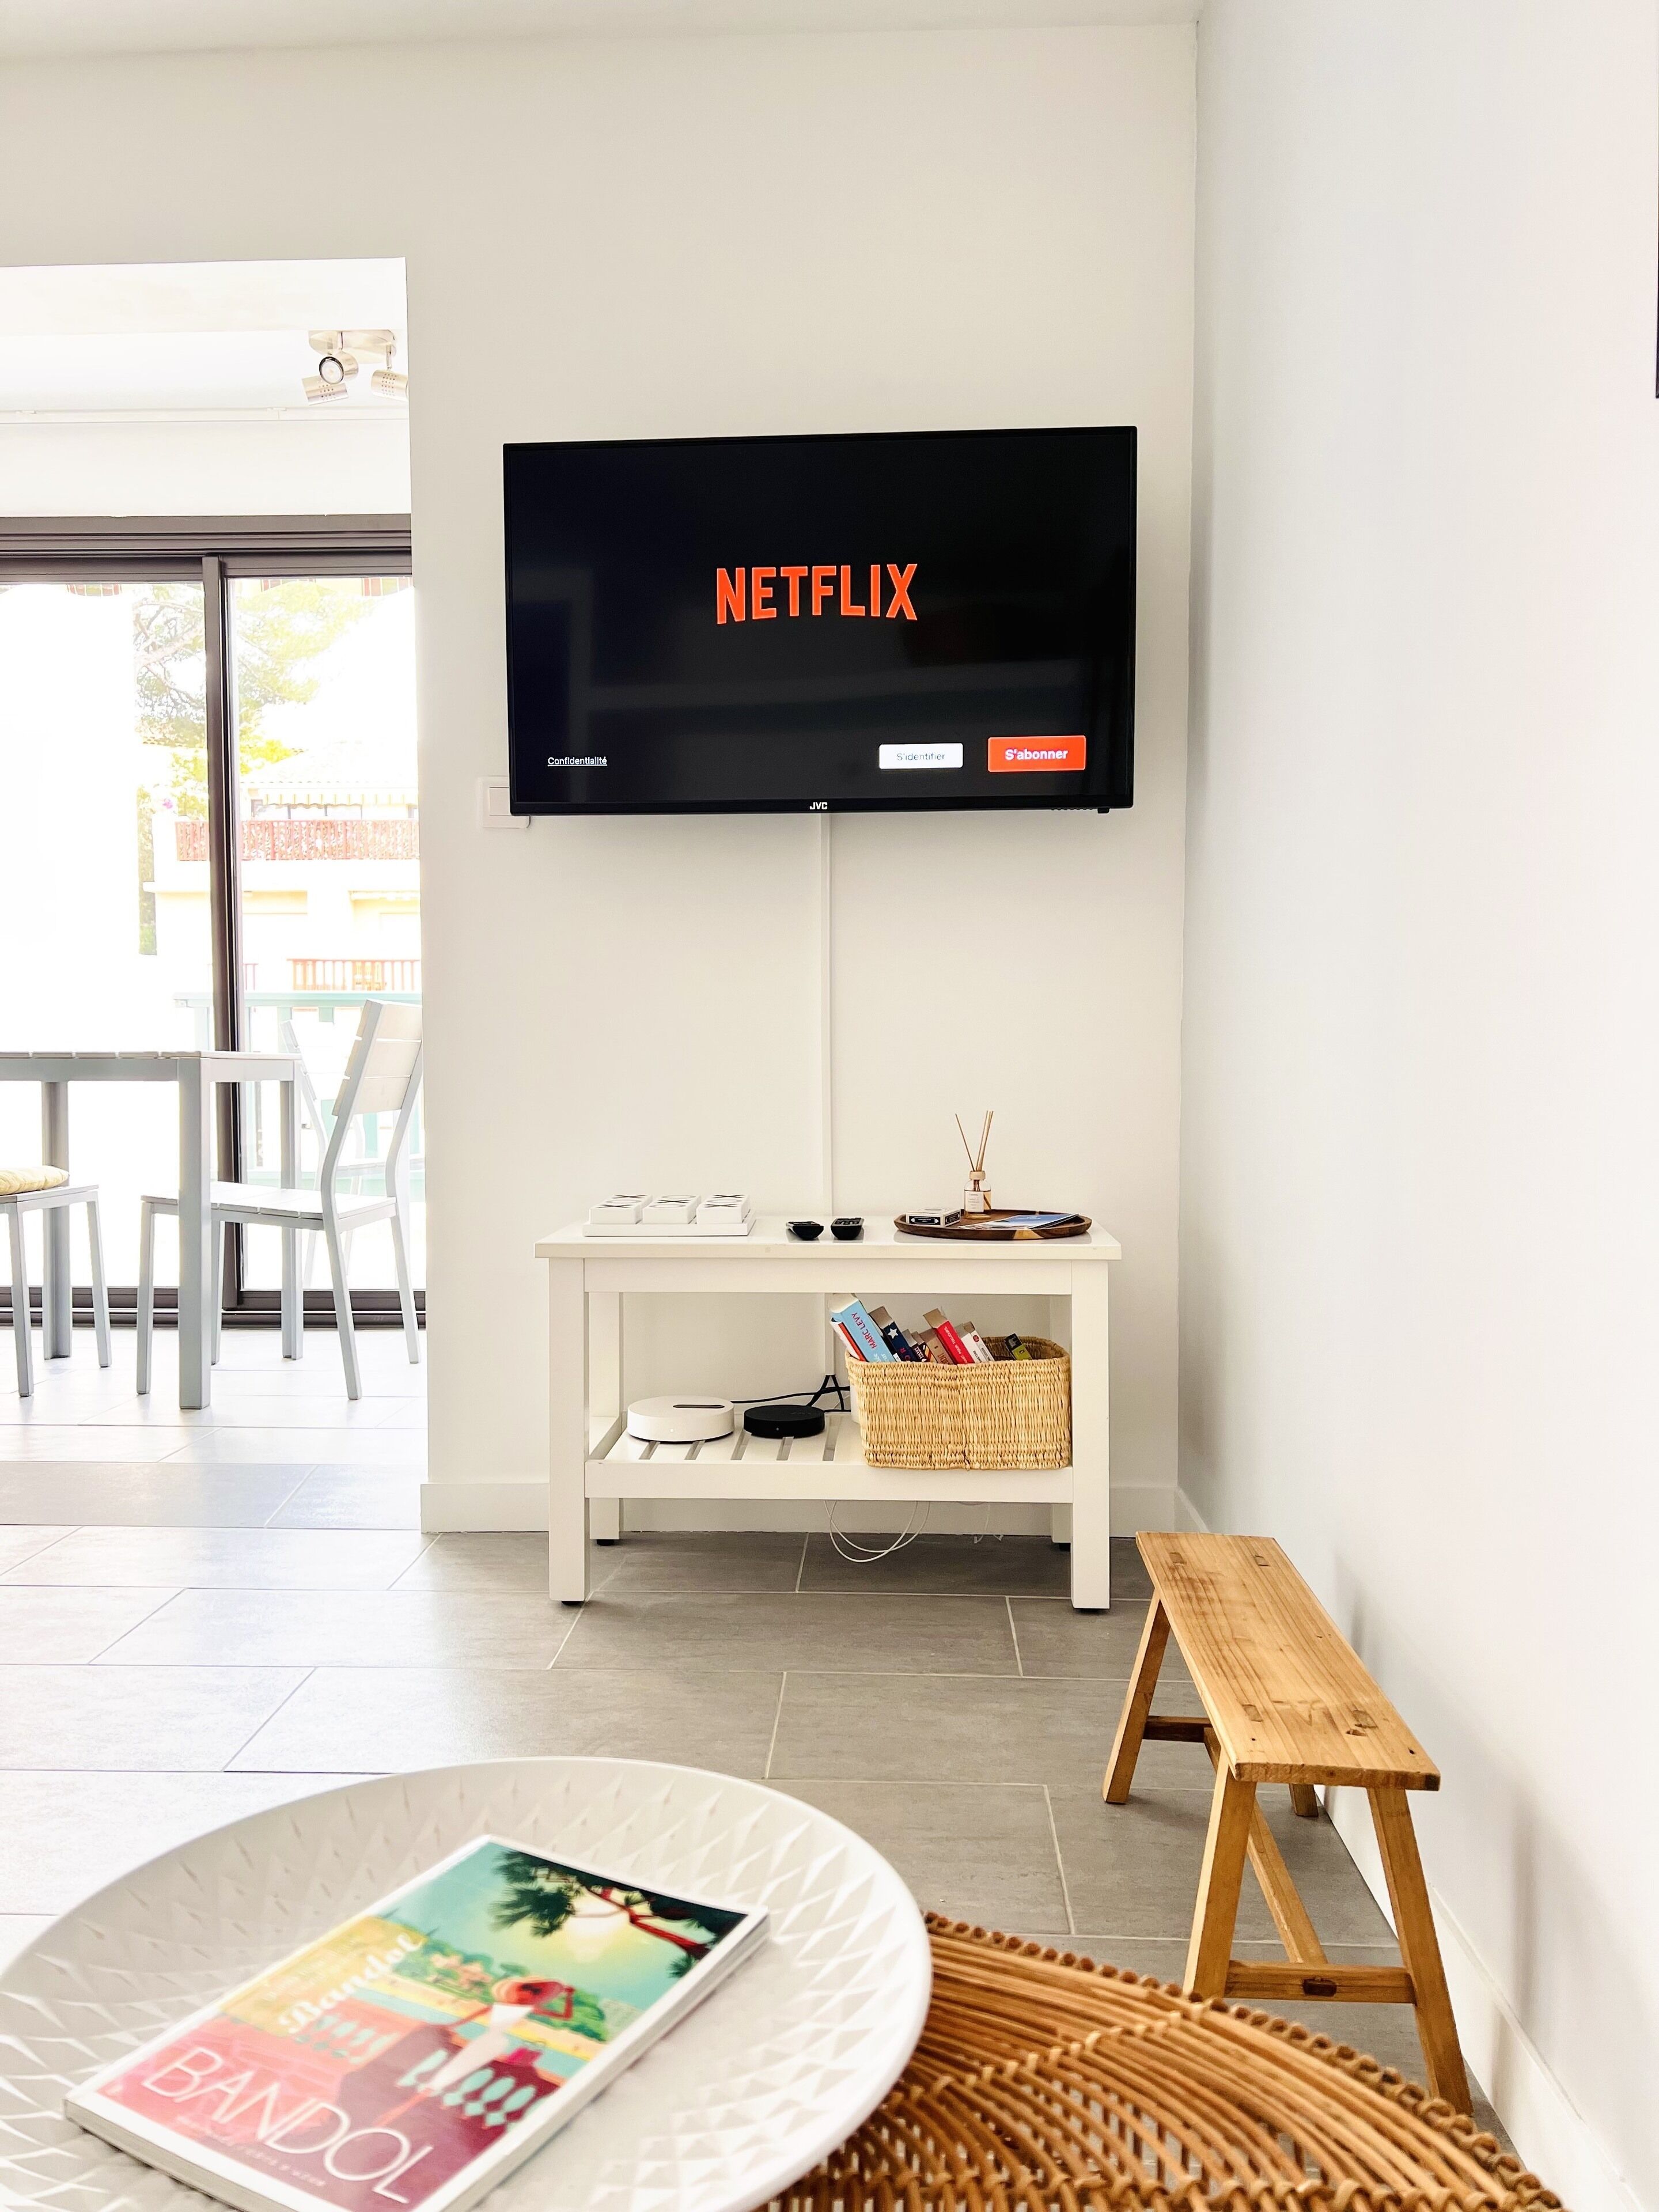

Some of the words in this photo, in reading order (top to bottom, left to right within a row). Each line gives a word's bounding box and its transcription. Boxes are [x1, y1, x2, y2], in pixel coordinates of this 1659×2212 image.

[717, 563, 918, 624] NETFLIX
[547, 756, 607, 765] Confidentialité
[896, 752, 945, 760] S'identifier
[1005, 748, 1069, 761] S'abonner
[809, 801, 828, 810] JVC
[851, 1312, 865, 1330] LEVY
[862, 1329, 878, 1349] MARC
[141, 2046, 434, 2204] BANDOL
